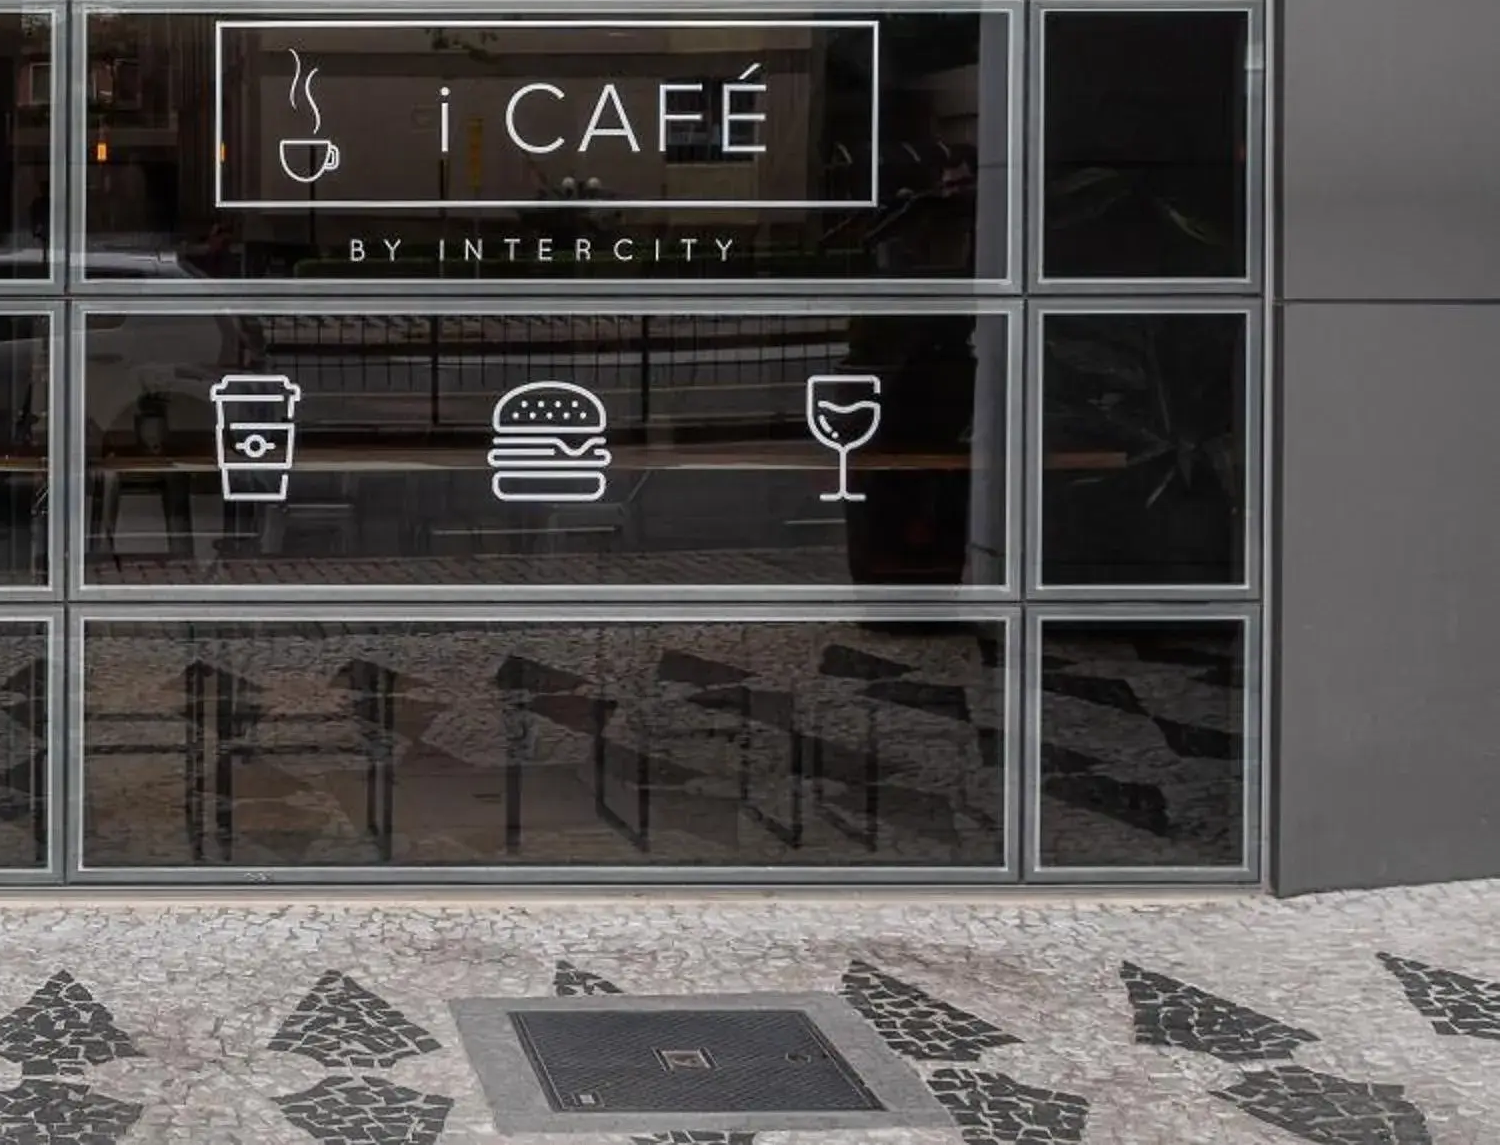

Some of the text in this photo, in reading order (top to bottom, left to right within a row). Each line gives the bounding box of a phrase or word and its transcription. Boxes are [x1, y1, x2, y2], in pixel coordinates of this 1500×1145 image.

[440, 63, 767, 154] i CAFÉ
[350, 238, 735, 262] BY INTERCITY
